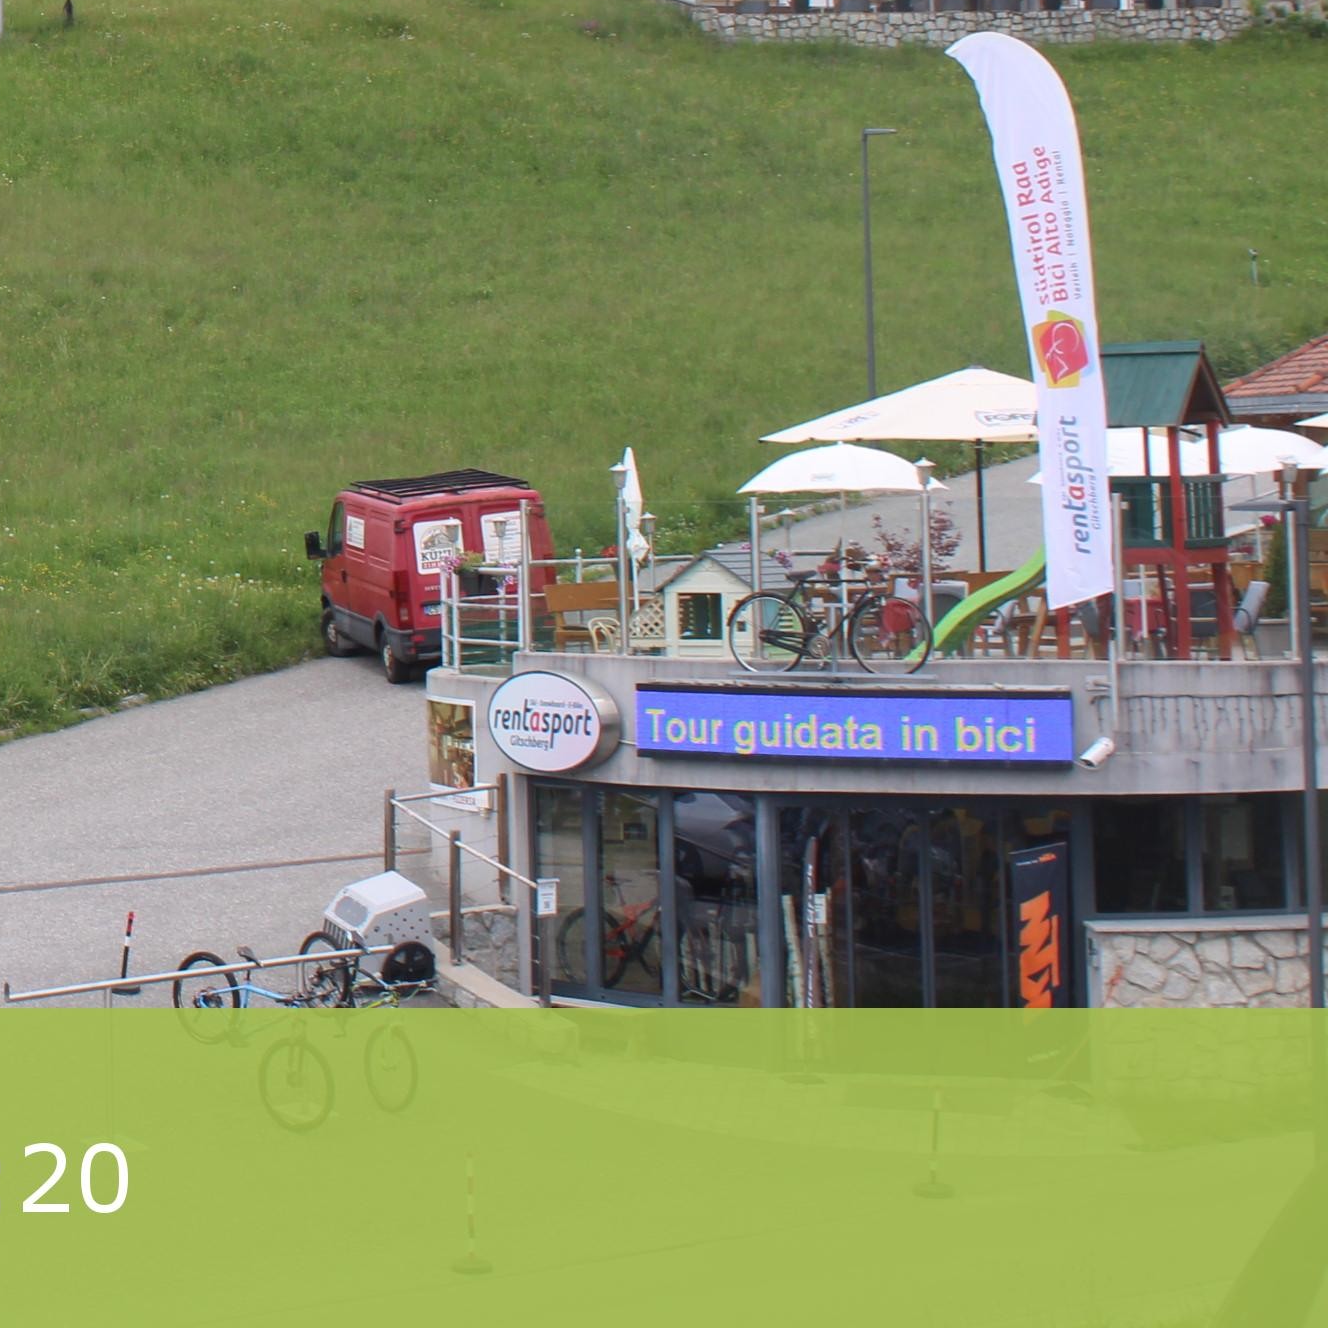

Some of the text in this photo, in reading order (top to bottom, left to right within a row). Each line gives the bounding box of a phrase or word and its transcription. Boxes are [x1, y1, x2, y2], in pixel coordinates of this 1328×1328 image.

[1012, 161, 1036, 207] Rad
[1033, 146, 1069, 303] Bici Alto Adige
[1059, 415, 1094, 554] rentasport
[494, 698, 592, 749] rentasport
[645, 708, 1036, 755] Tour guidata in bici
